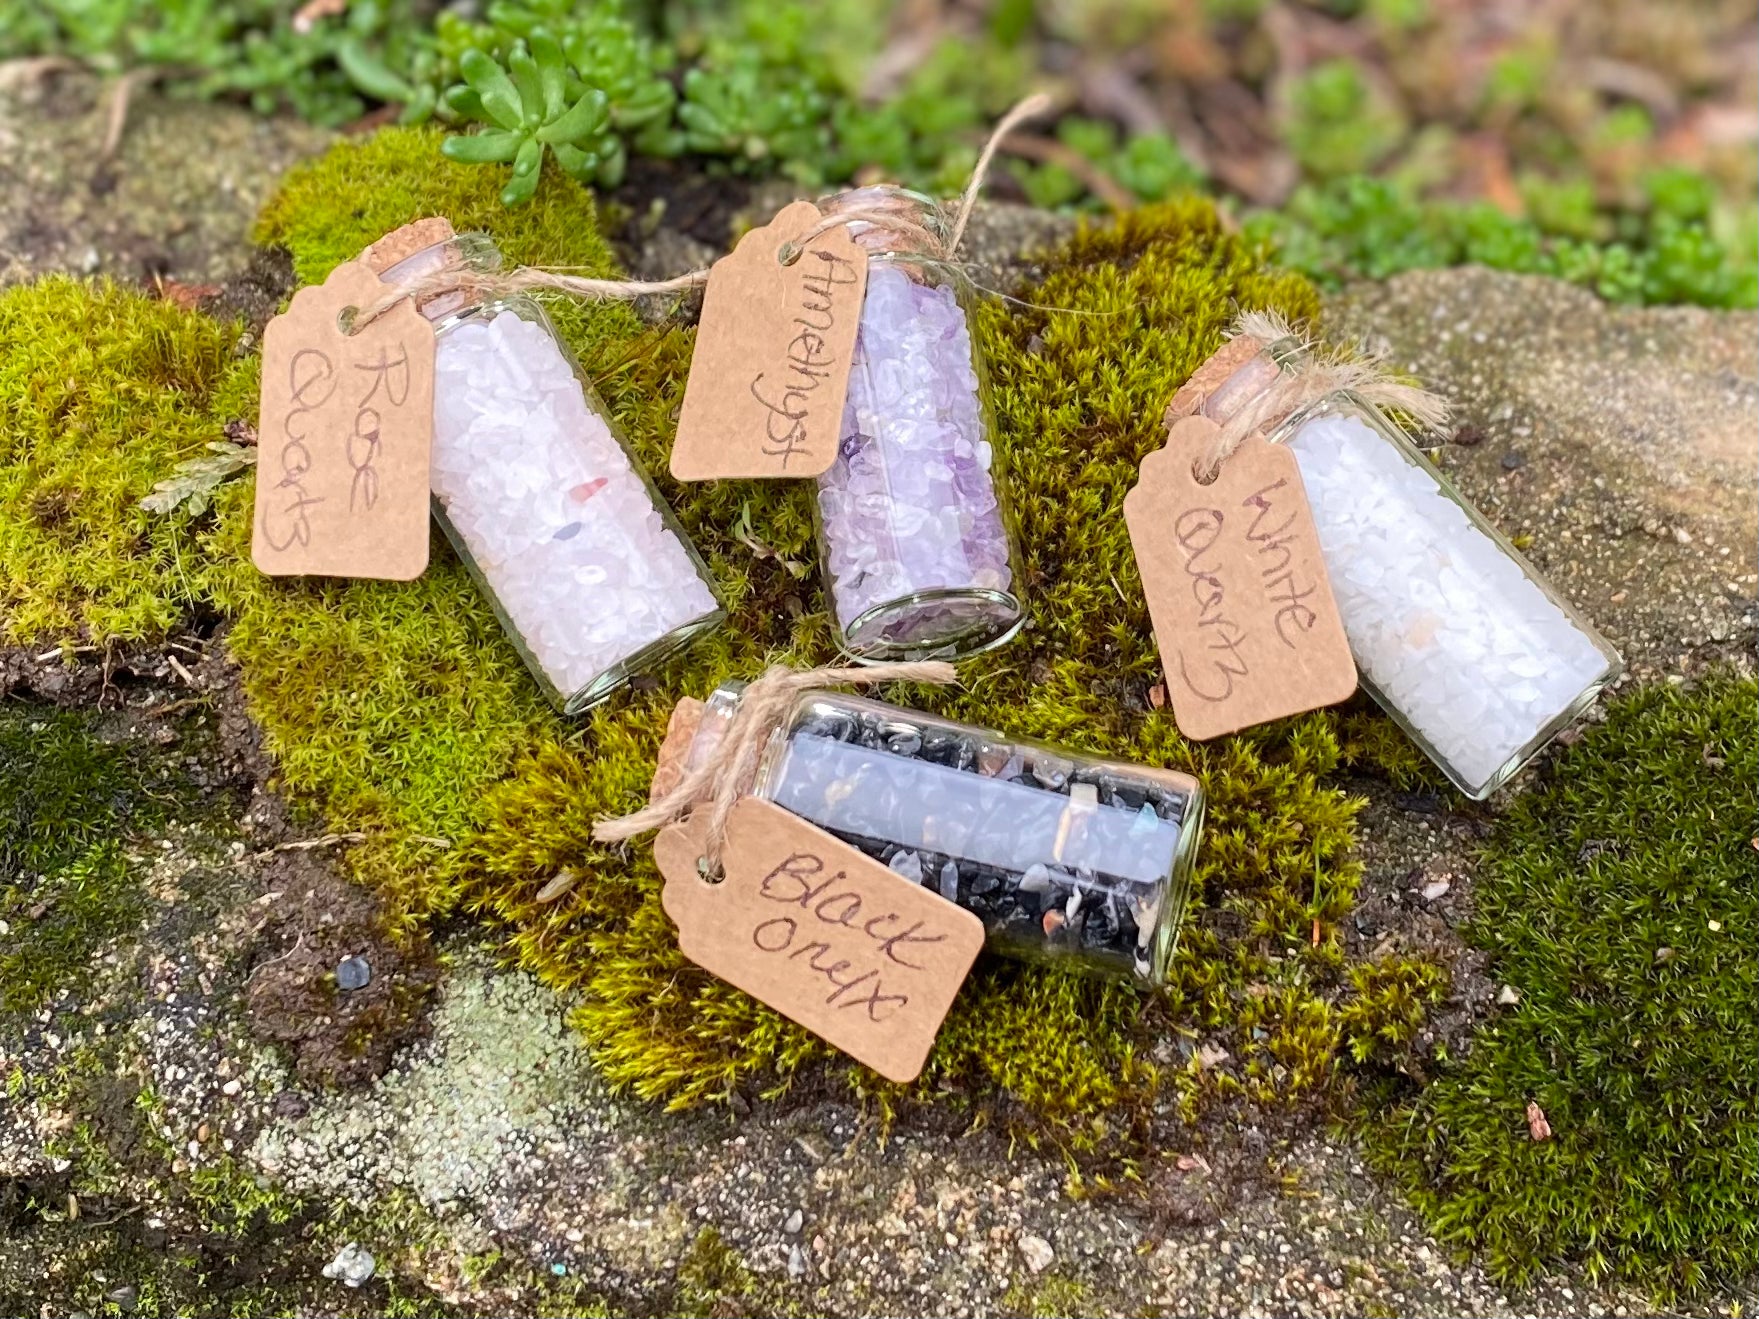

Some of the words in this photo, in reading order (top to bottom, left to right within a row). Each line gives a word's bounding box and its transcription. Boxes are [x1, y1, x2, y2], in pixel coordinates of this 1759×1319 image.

[261, 348, 337, 552] Quartz
[347, 340, 410, 513] Rose
[1174, 508, 1248, 702] Quartz
[1242, 478, 1317, 650] White
[753, 917, 908, 1023] Onyx
[759, 852, 949, 969] Black
